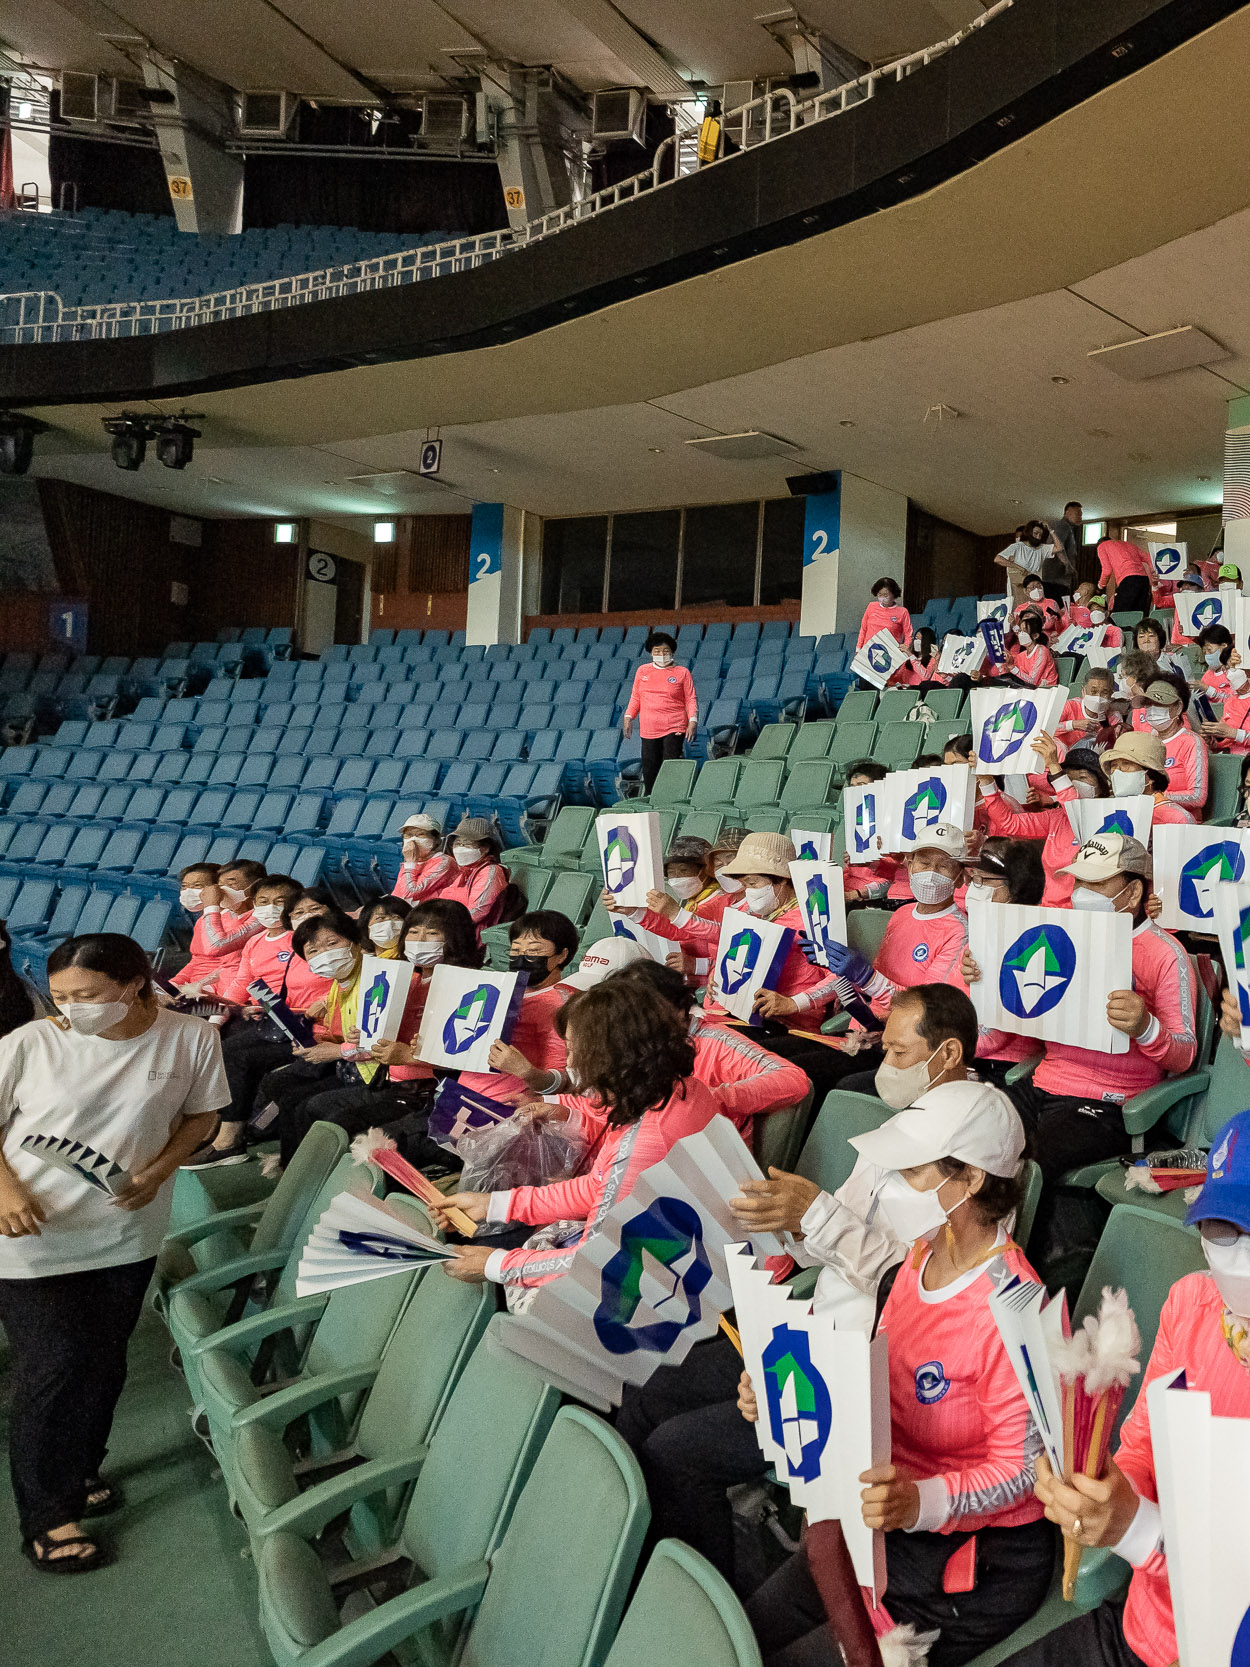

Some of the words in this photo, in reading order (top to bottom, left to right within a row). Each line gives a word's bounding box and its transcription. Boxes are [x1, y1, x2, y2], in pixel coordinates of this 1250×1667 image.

[172, 180, 187, 194] 37
[507, 191, 520, 205] 37
[426, 451, 433, 464] 2
[811, 530, 828, 560] 2
[316, 558, 329, 576] 2
[476, 553, 491, 578] 2
[61, 611, 73, 637] 1
